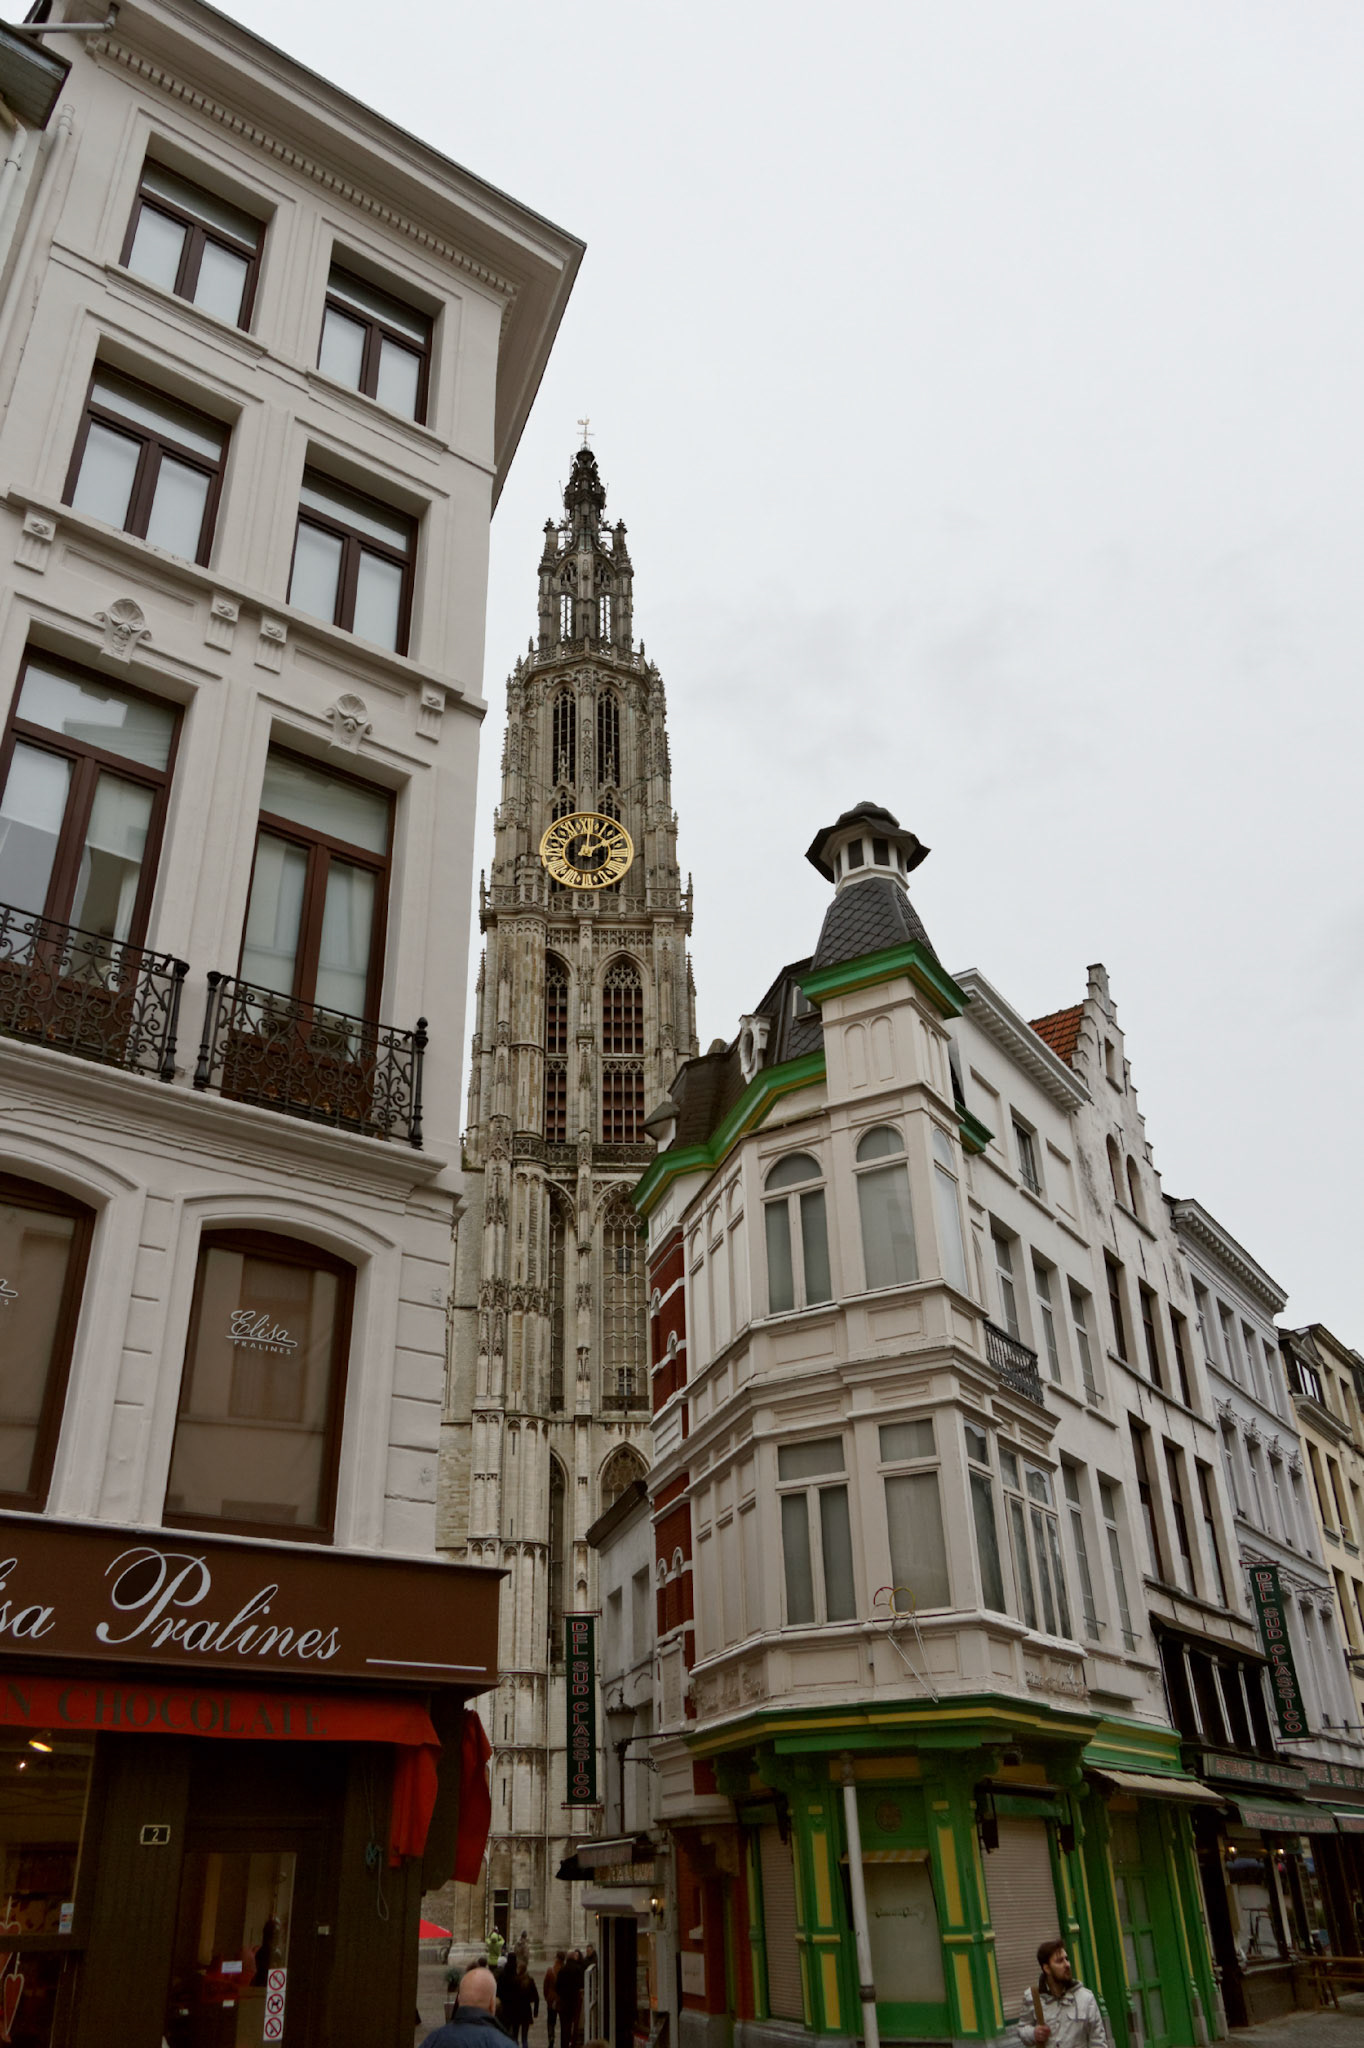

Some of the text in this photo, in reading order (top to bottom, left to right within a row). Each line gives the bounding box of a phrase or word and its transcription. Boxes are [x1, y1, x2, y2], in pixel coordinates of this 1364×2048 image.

[226, 1310, 298, 1346] Elisa
[234, 1339, 292, 1355] PRALINES
[96, 1547, 341, 1660] Pralines
[1254, 1572, 1303, 1733] DEL SUD CLASSICO
[57, 1685, 328, 1736] CHOCOLATE
[571, 1621, 590, 1798] DEL SUD CLASSICO
[151, 1827, 160, 1842] 2
